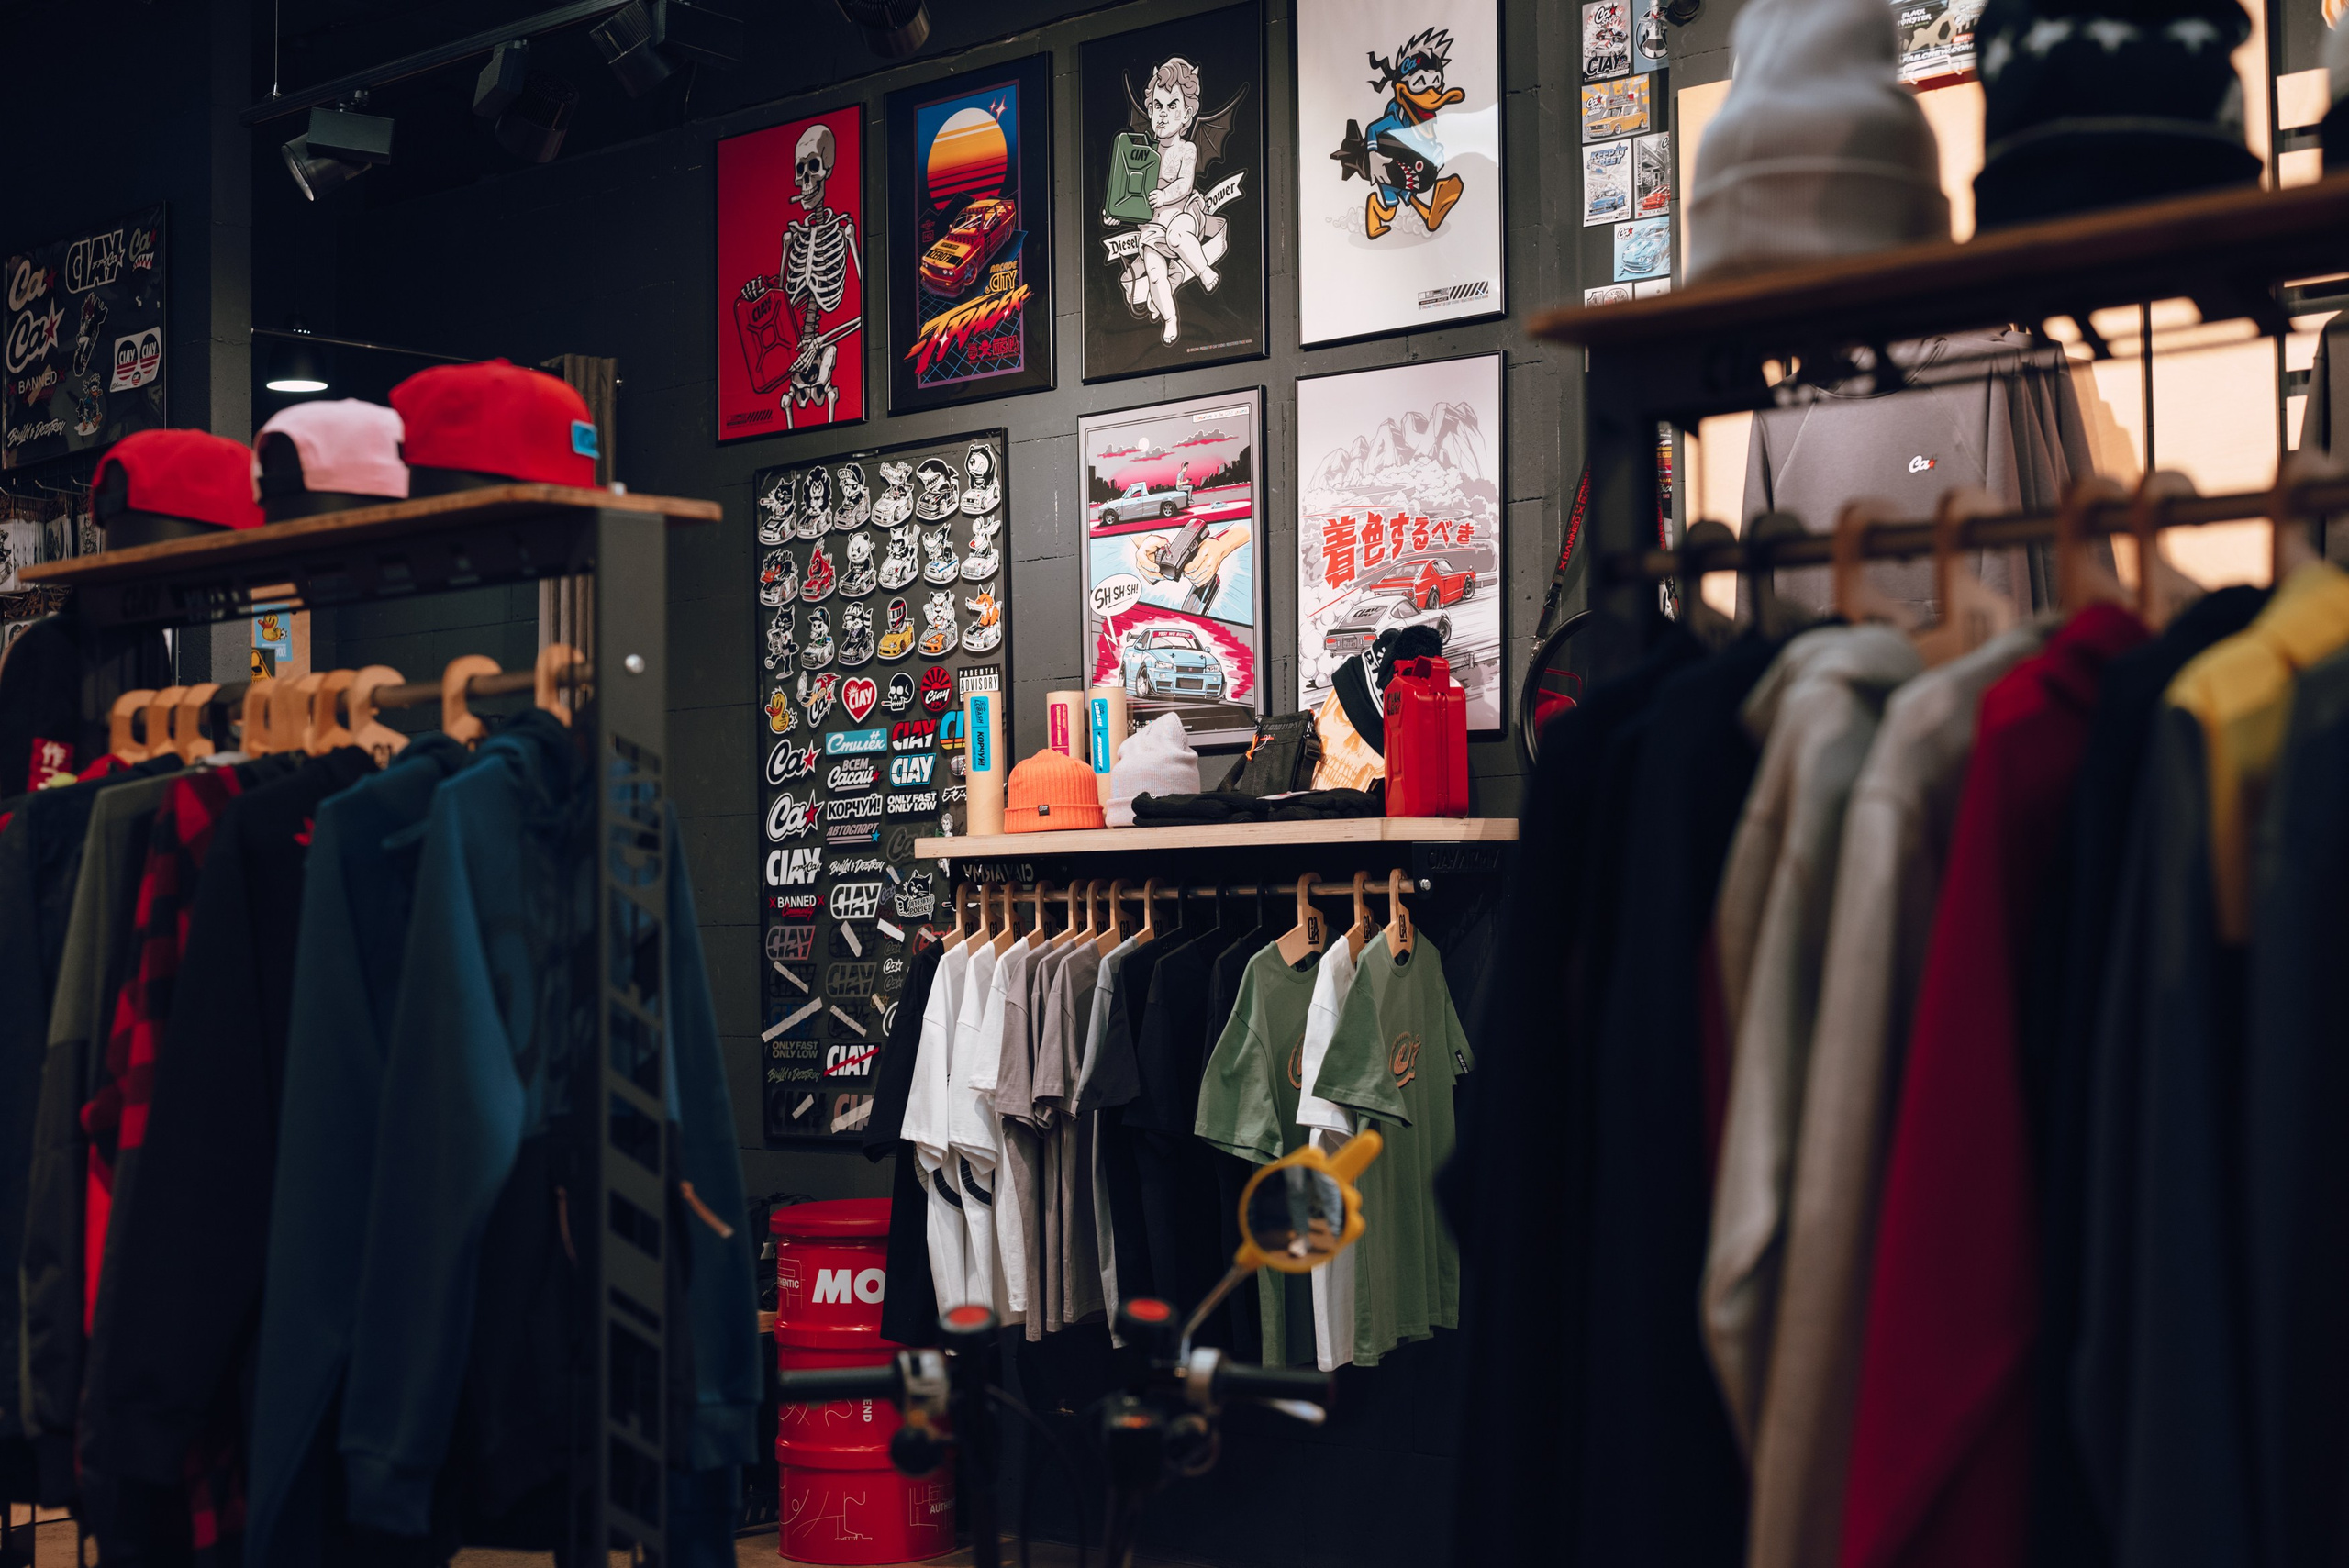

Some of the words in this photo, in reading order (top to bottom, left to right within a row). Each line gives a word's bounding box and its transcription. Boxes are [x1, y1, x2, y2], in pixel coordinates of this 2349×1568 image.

[1109, 236, 1139, 255] Diesel
[989, 260, 1018, 273] ARCADE
[989, 269, 1019, 292] CITY
[18, 371, 58, 395] BANNED
[1563, 515, 1581, 560] BANNED
[1322, 510, 1475, 590] 着色するべき
[959, 666, 998, 677] PARENTAL
[960, 676, 998, 691] ADVISORY
[842, 757, 870, 772] ВСЕМ
[886, 795, 913, 805] ONLY
[912, 792, 937, 803] FAST
[827, 794, 882, 820] КОРЧУЙ!
[886, 803, 914, 814] ONLY
[913, 801, 937, 812] LOW
[827, 822, 879, 836] АВТОСПОРТ
[777, 895, 817, 908] BANNED
[909, 905, 931, 916] POLICE
[772, 1041, 796, 1051] ONLY
[797, 1041, 818, 1050] FAST
[772, 1050, 796, 1058] ONLY
[796, 1050, 818, 1058] LOW
[863, 1398, 872, 1422] END
